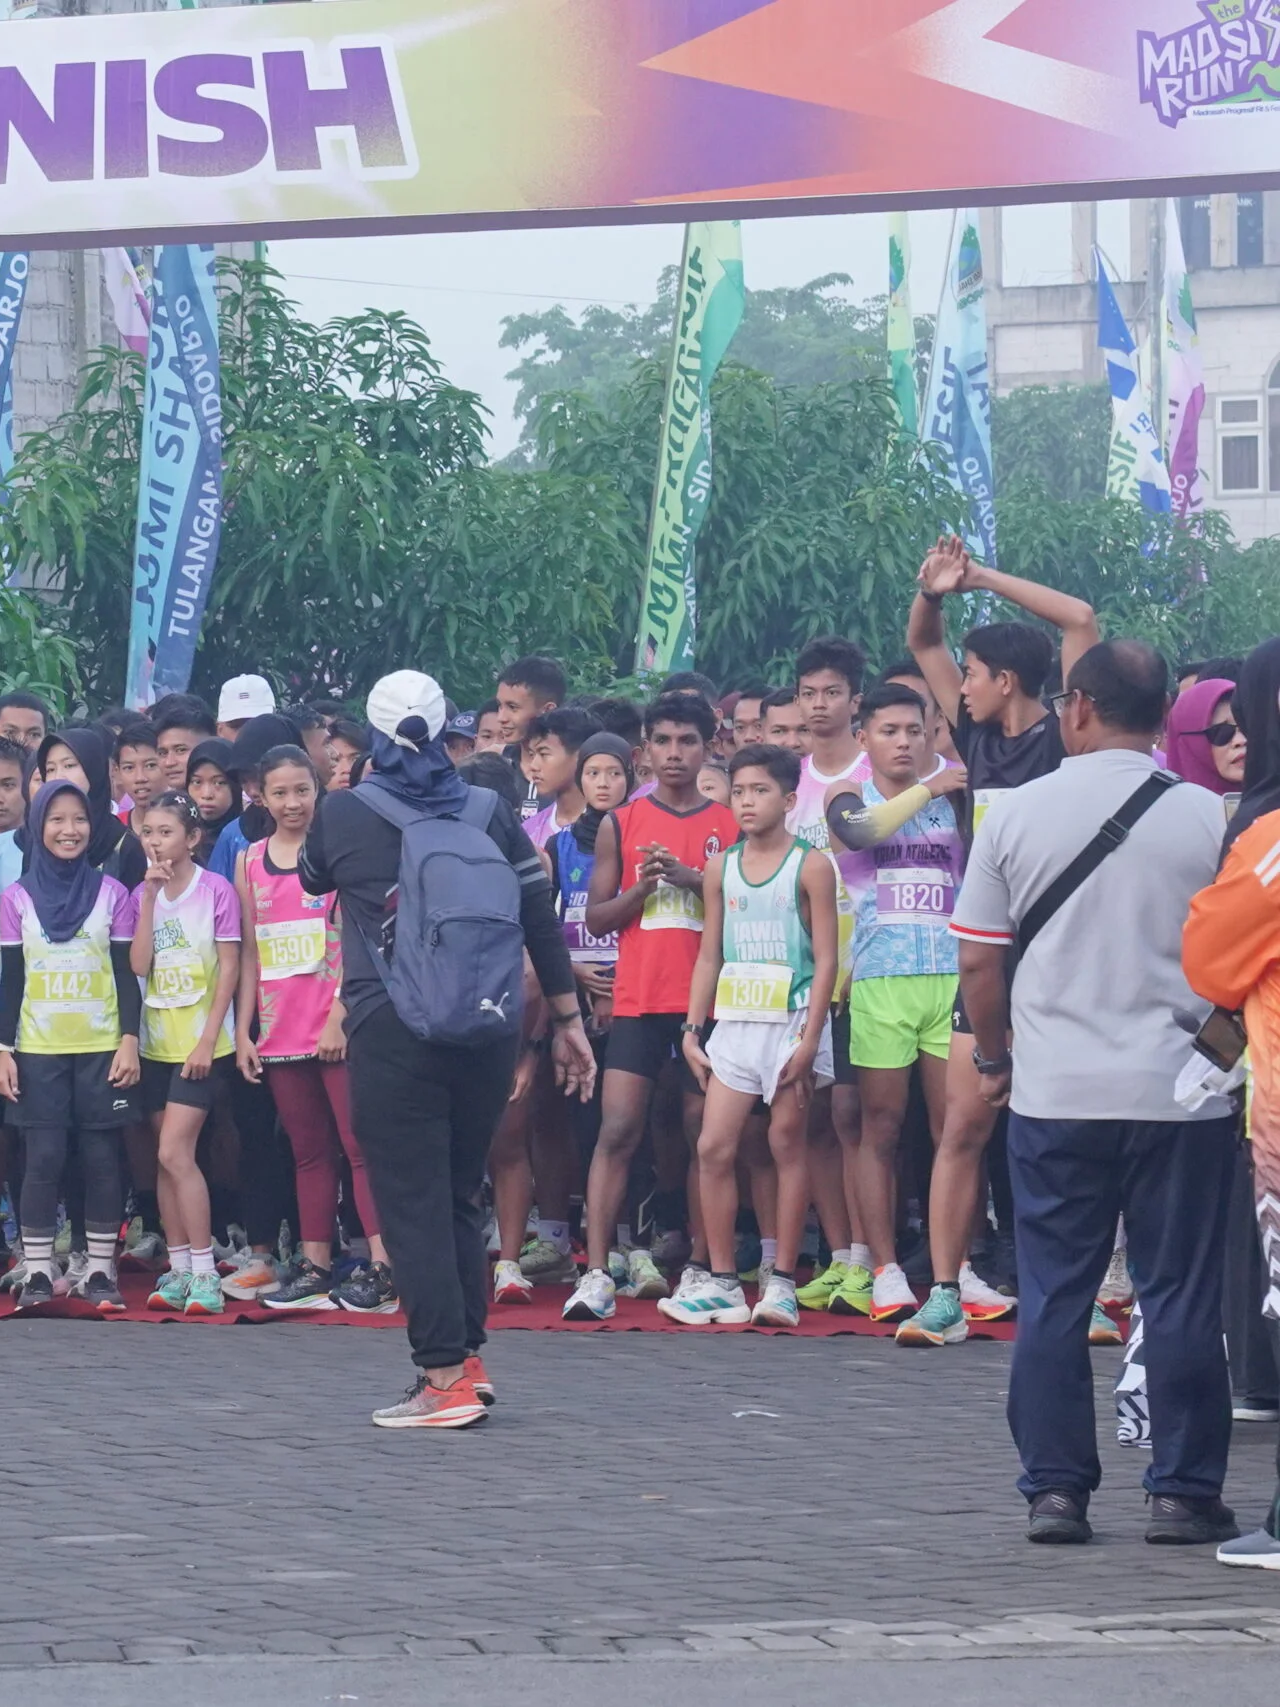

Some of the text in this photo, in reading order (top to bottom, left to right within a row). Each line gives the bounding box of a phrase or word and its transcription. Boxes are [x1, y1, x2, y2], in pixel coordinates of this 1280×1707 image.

[1217, 4, 1241, 19] the
[1157, 61, 1234, 118] RUN
[655, 889, 696, 916] 1314
[890, 884, 945, 912] 1820
[268, 935, 315, 965] 1590
[735, 941, 788, 962] TIMUR
[41, 972, 93, 999] 1442
[730, 979, 777, 1007] 1307
